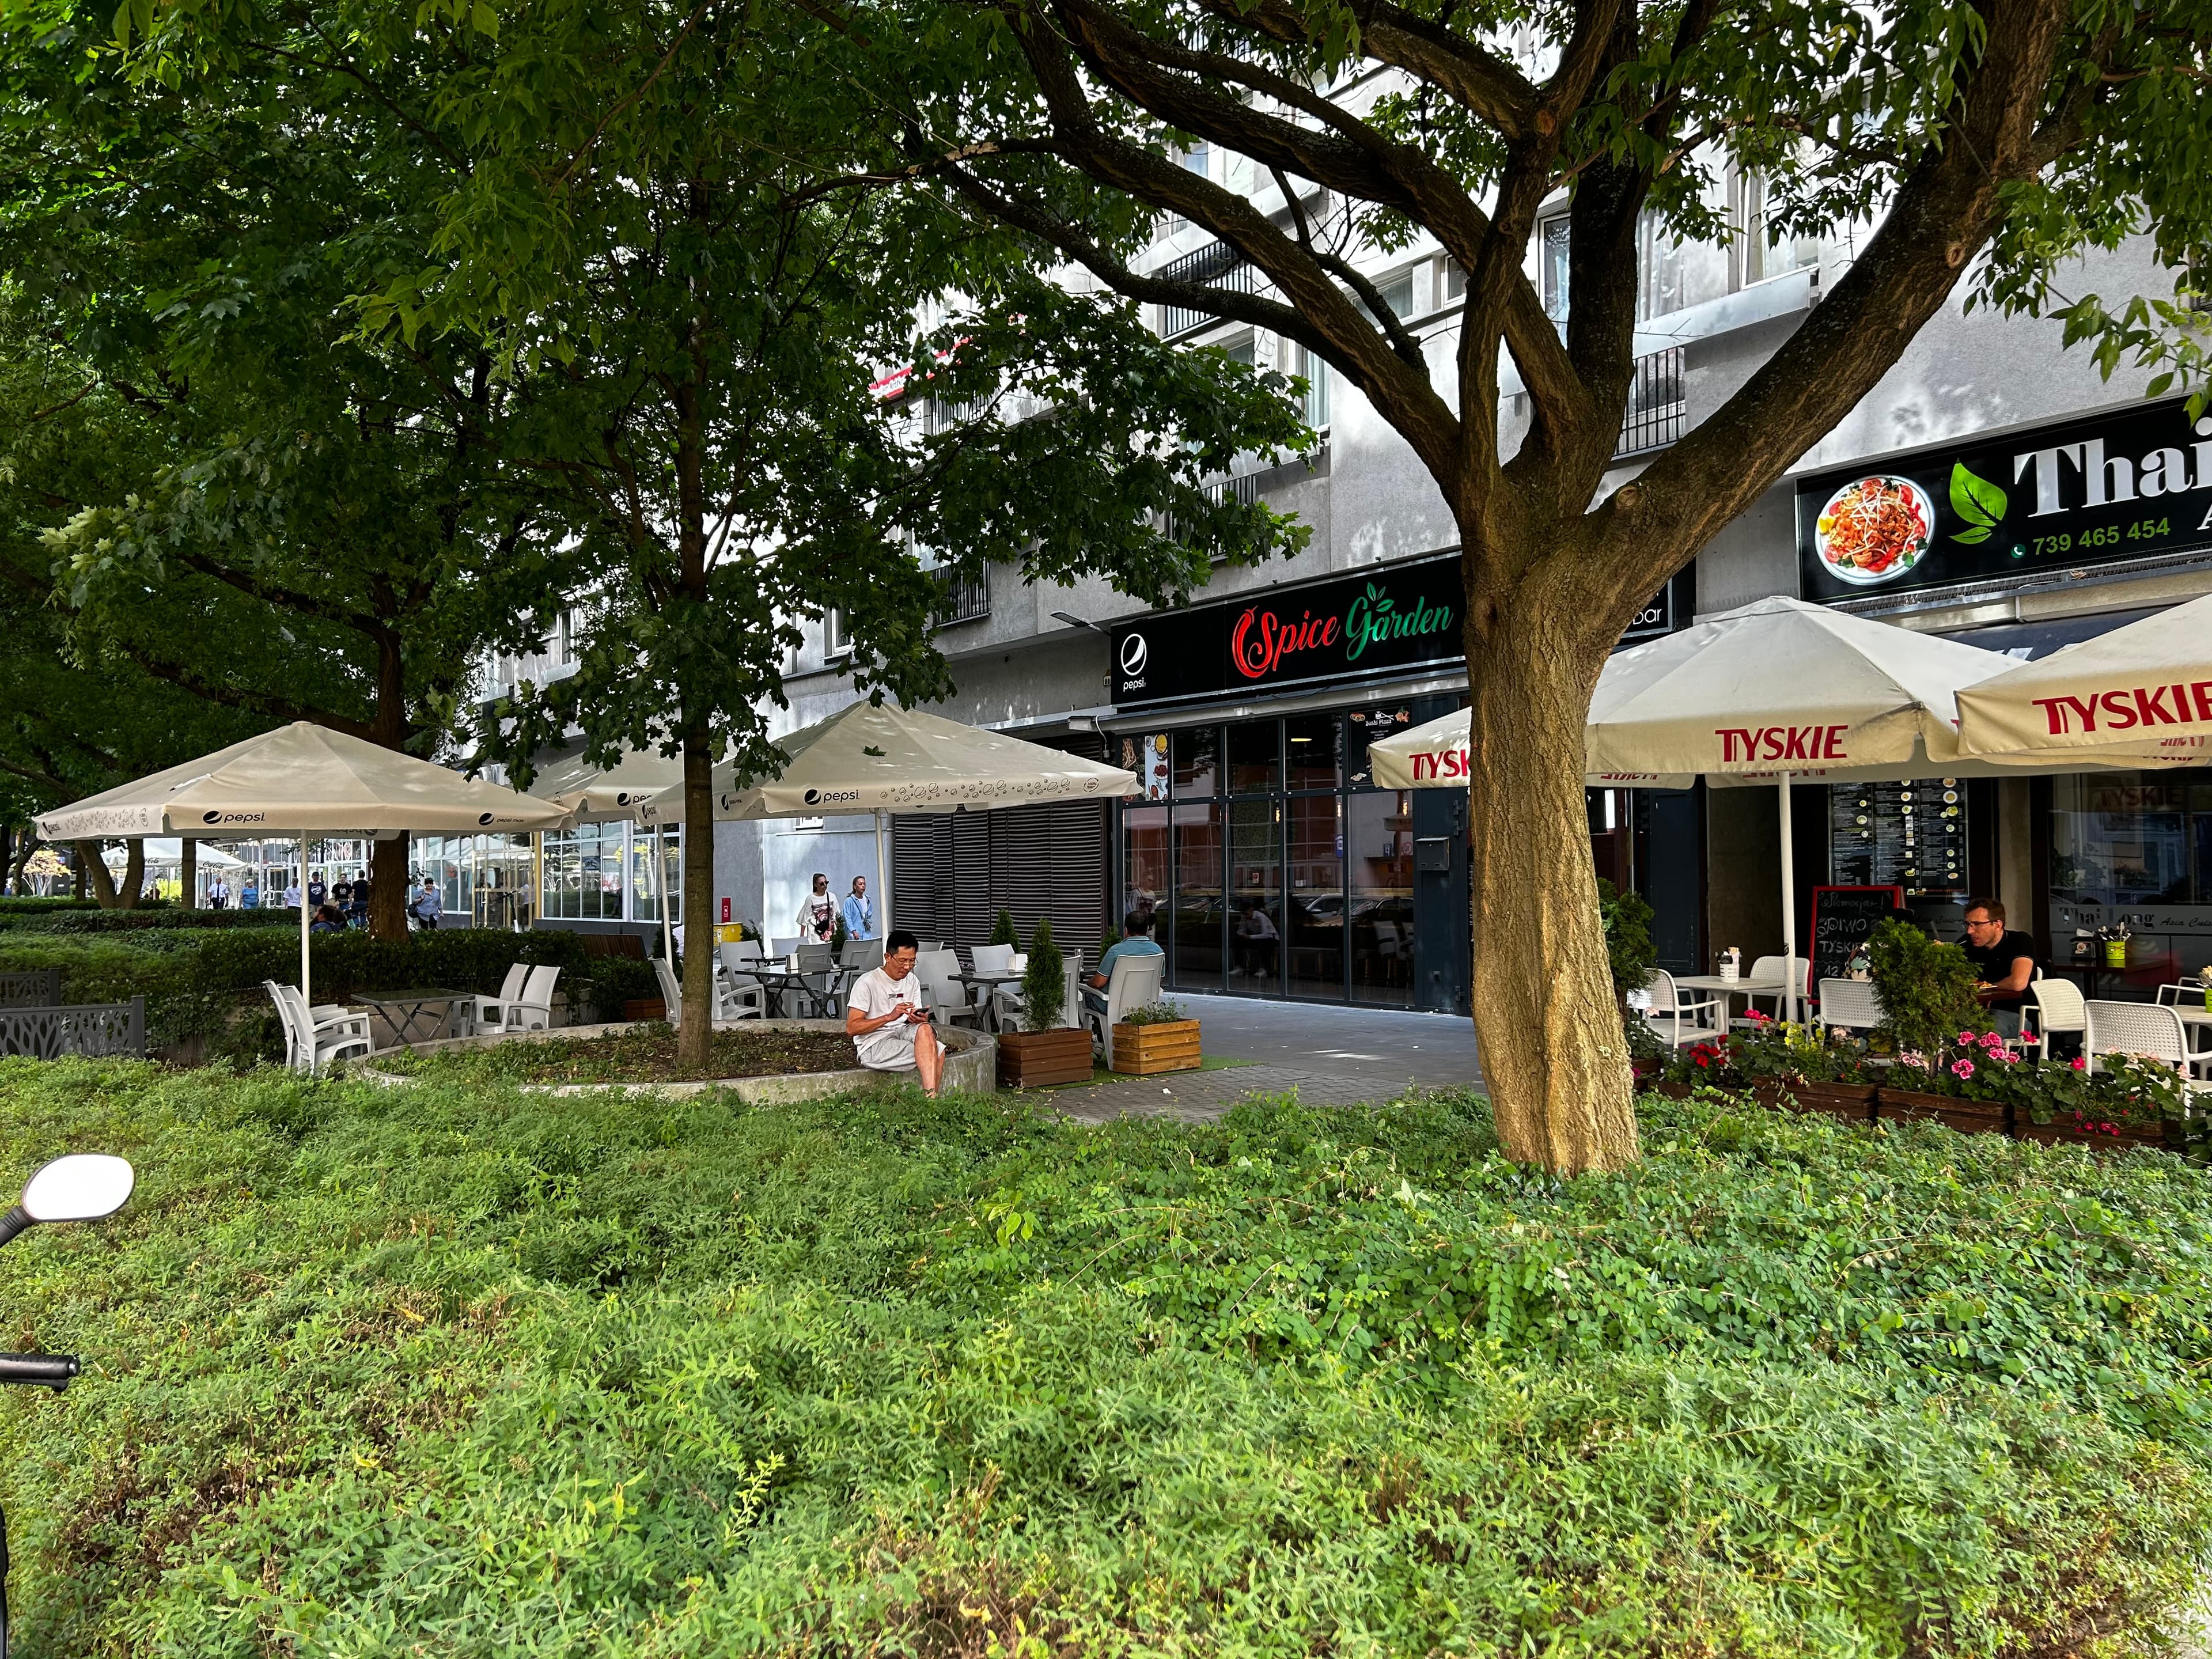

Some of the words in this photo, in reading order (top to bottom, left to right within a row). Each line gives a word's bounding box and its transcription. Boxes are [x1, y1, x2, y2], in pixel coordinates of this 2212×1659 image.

[2014, 417, 2212, 517] Thai
[2033, 534, 2071, 555] 739
[2078, 525, 2120, 547] 465
[2127, 517, 2171, 540] 454
[1232, 608, 1340, 677] Spice
[1346, 594, 1454, 661] Garden
[1123, 677, 1145, 692] pepsi
[2032, 681, 2212, 735] TYSKIE
[1715, 725, 1848, 762] TYSKIE
[823, 789, 860, 804] pepsi
[224, 812, 265, 823] pepsi
[1817, 918, 1866, 938] PIWO
[1825, 965, 1839, 977] 12
